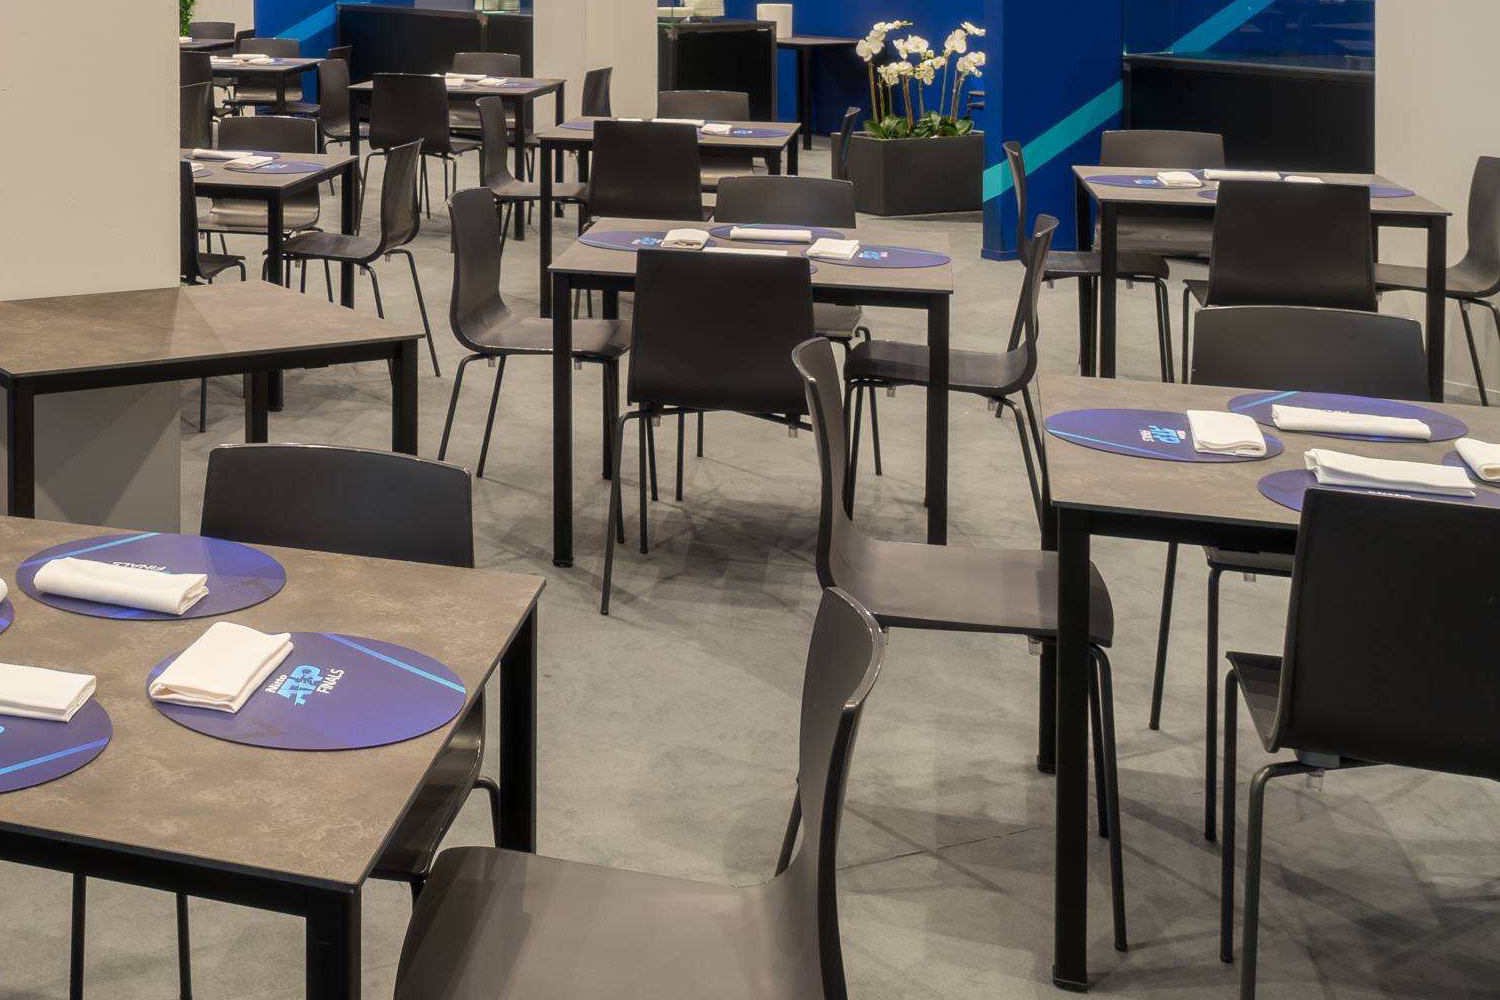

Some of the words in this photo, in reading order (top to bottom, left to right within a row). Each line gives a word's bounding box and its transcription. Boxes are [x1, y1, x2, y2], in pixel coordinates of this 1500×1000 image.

[264, 674, 288, 694] Nitto
[277, 664, 324, 706] ATP
[316, 668, 345, 694] FINALS
